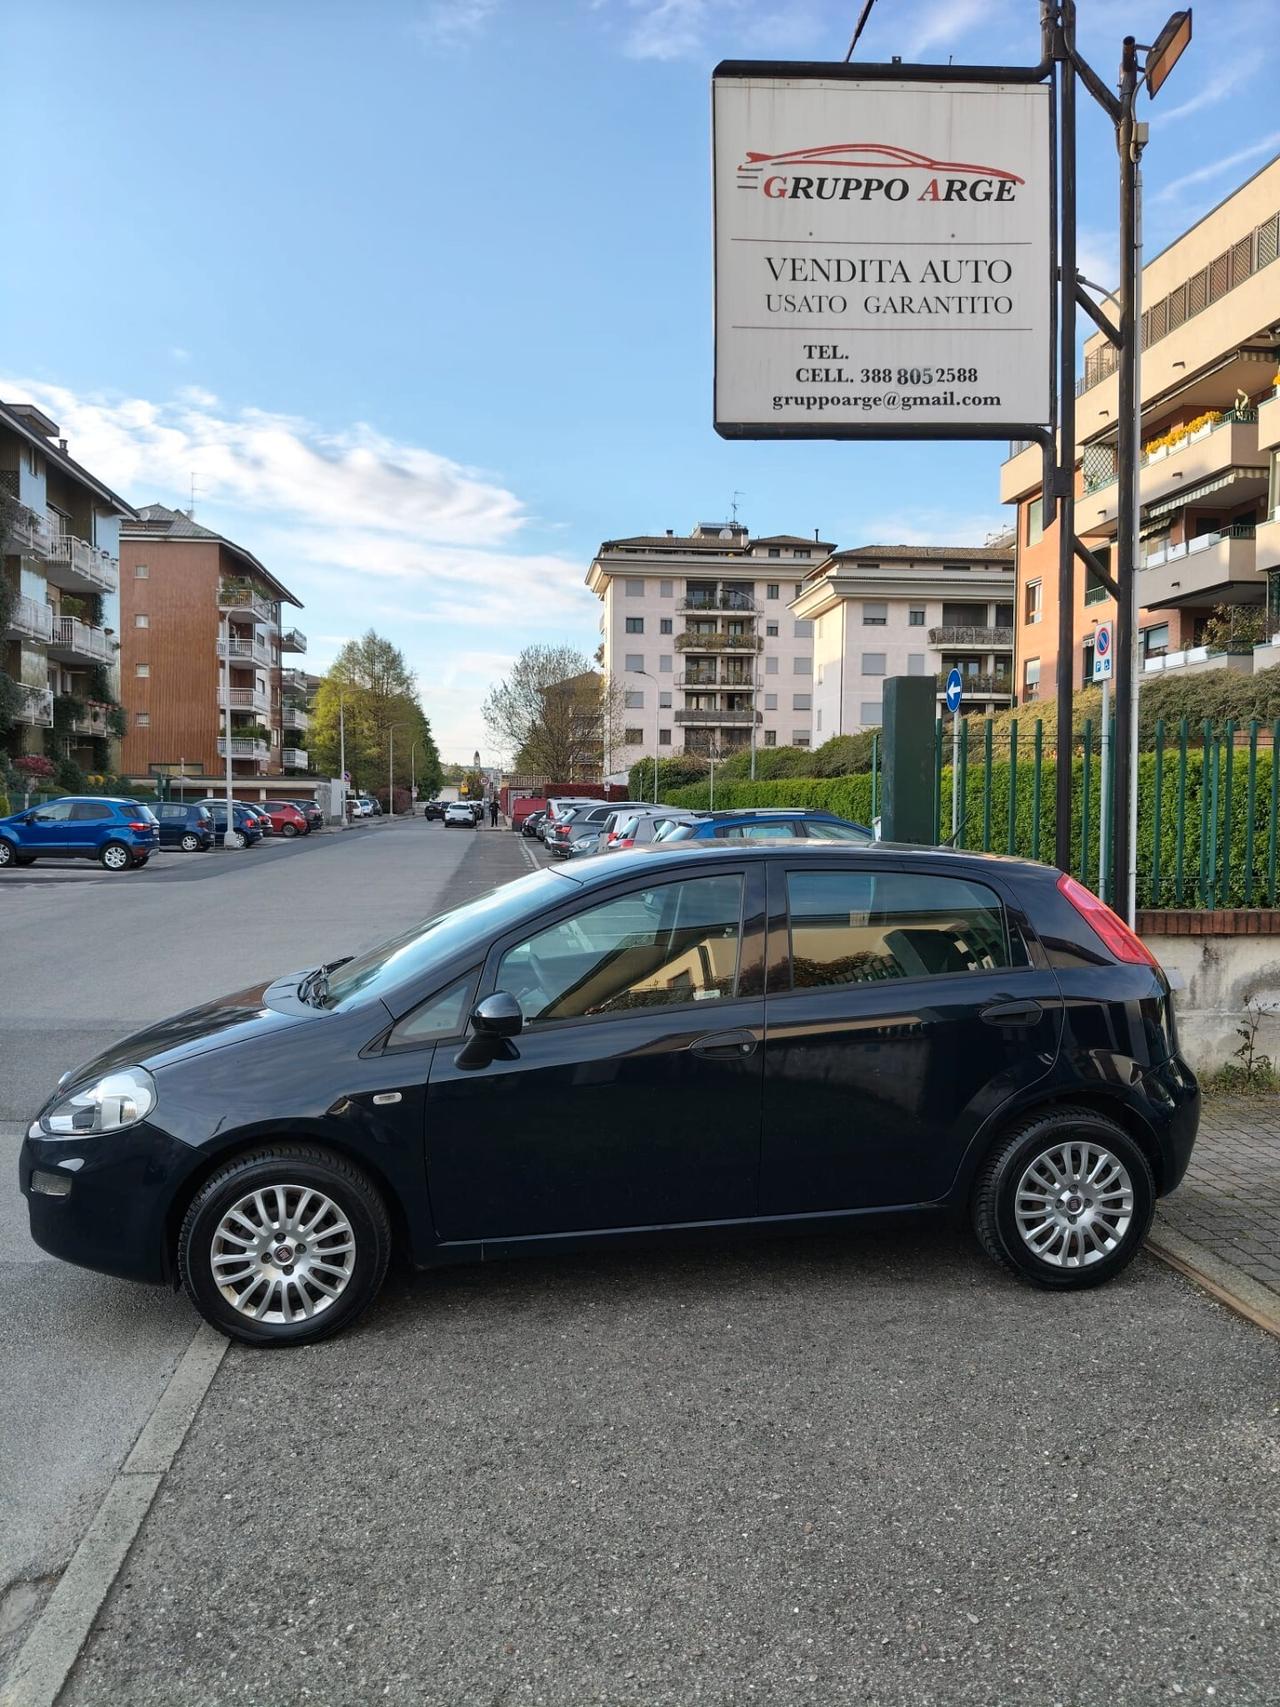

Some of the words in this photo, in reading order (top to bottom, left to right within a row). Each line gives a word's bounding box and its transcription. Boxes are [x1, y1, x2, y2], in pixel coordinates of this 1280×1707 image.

[763, 175, 910, 202] GRUPPO
[917, 178, 1017, 203] ARGE
[764, 256, 912, 284] VENDITA
[919, 259, 1013, 284] AUTO
[765, 294, 848, 314] USATO
[863, 295, 1013, 314] GARANTITO
[802, 344, 849, 360] TEL.
[795, 368, 854, 384] CELL.
[860, 368, 893, 384] 388
[772, 391, 1002, 411] gruppoarge@gmail.com
